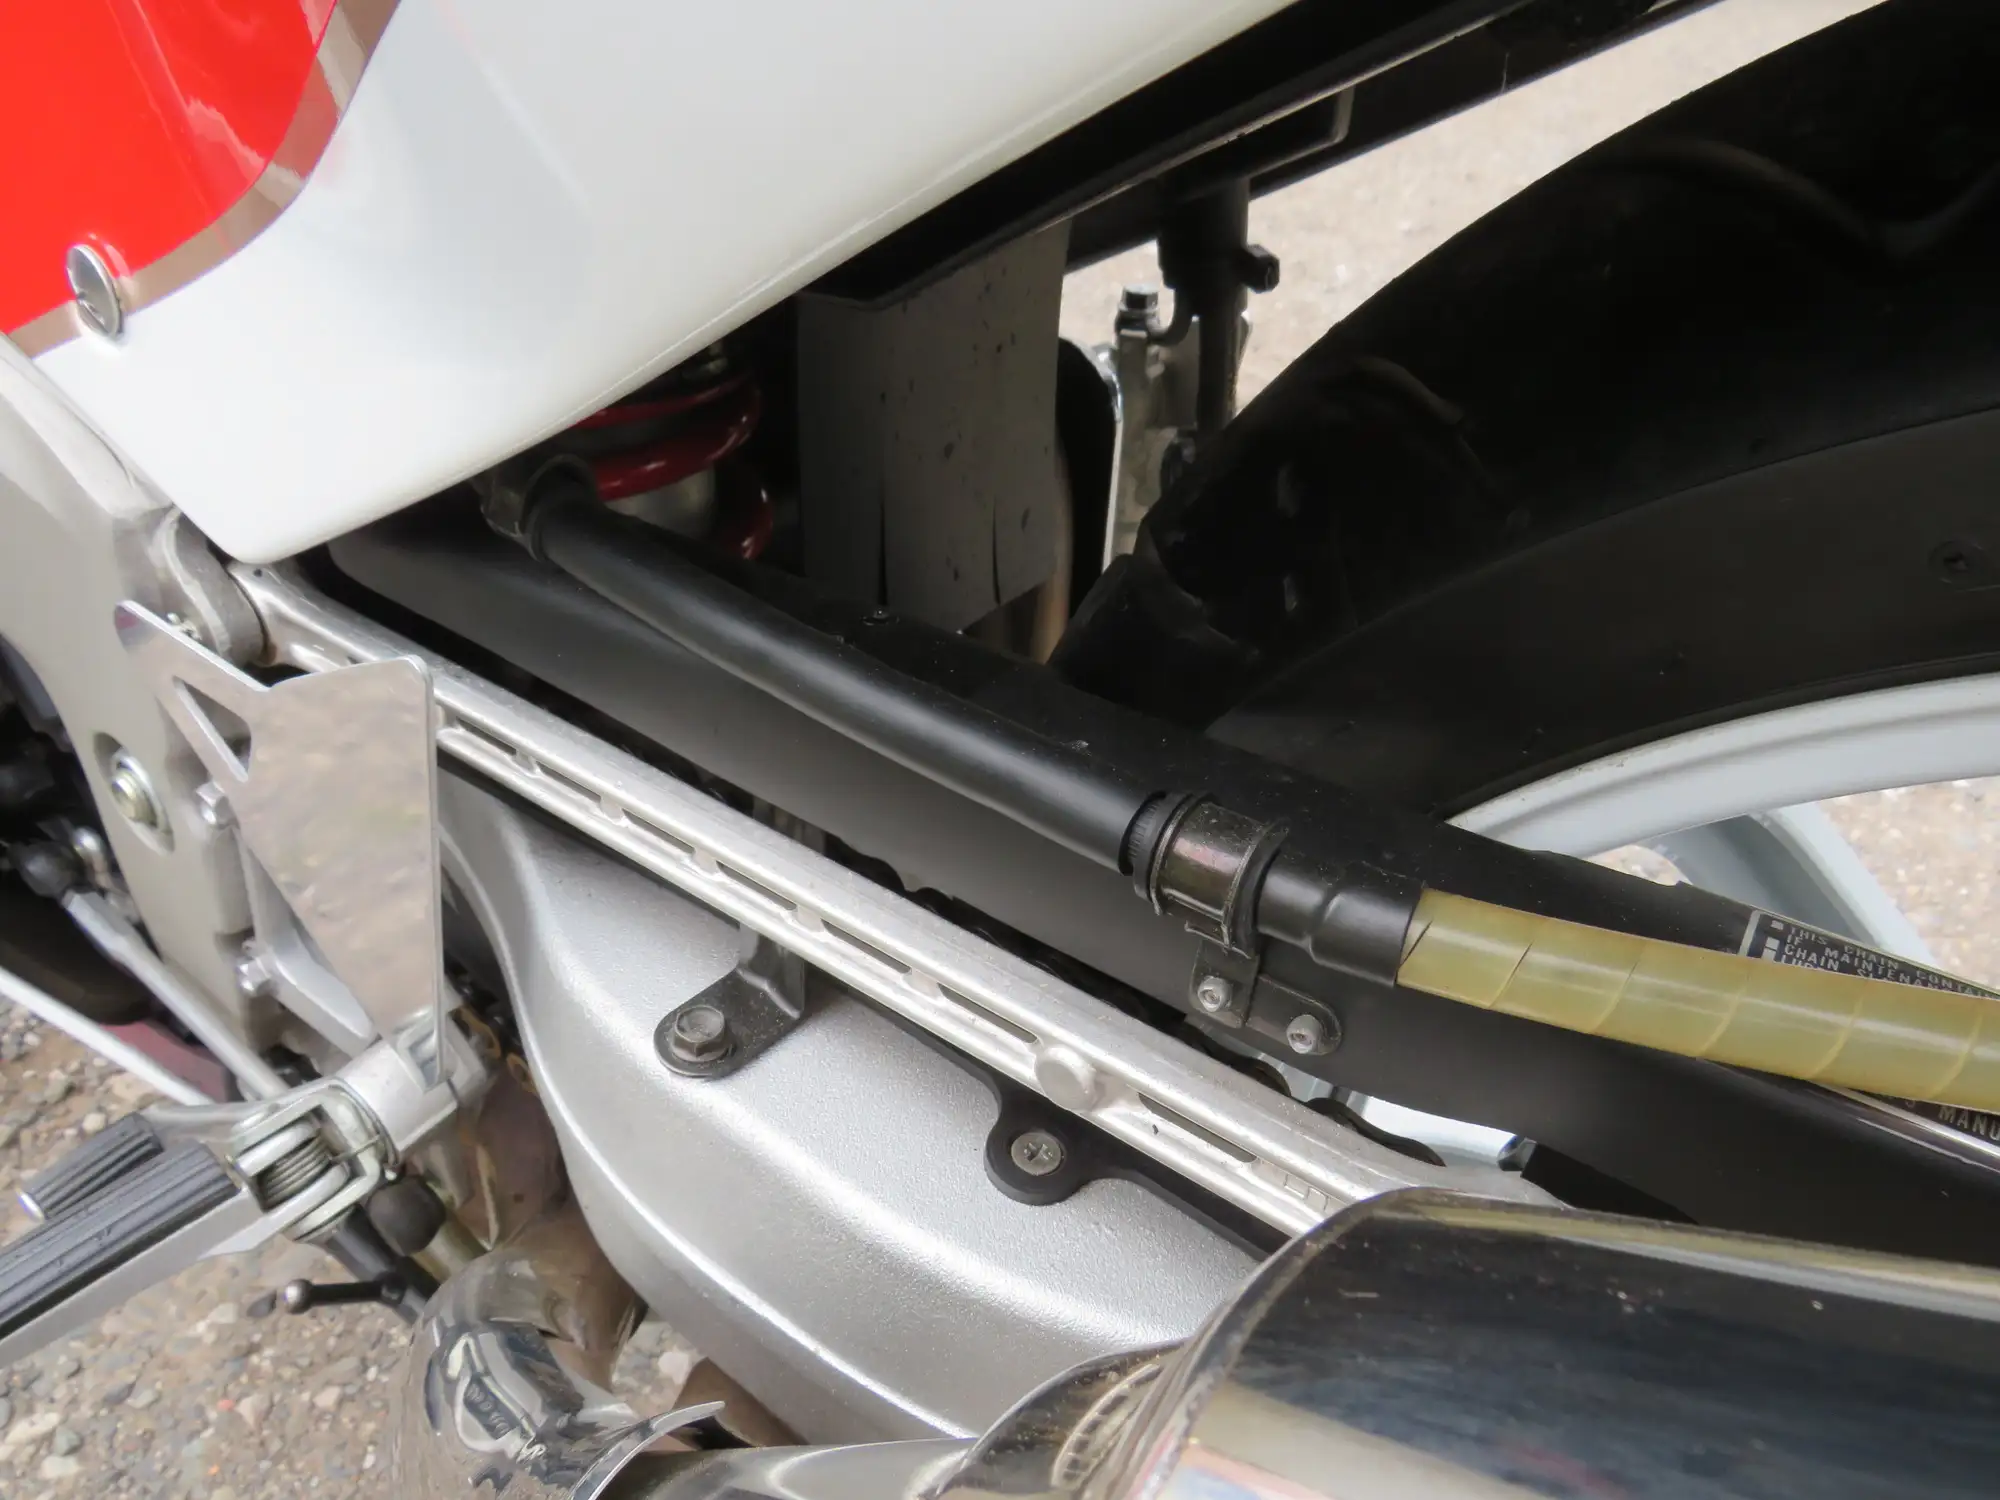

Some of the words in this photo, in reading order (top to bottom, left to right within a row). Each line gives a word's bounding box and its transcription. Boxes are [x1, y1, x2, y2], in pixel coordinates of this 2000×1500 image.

[1786, 934, 1802, 946] IF
[1790, 926, 1828, 946] THIS
[1844, 945, 1899, 970] CHAIN
[1784, 944, 1840, 971] CHAIN
